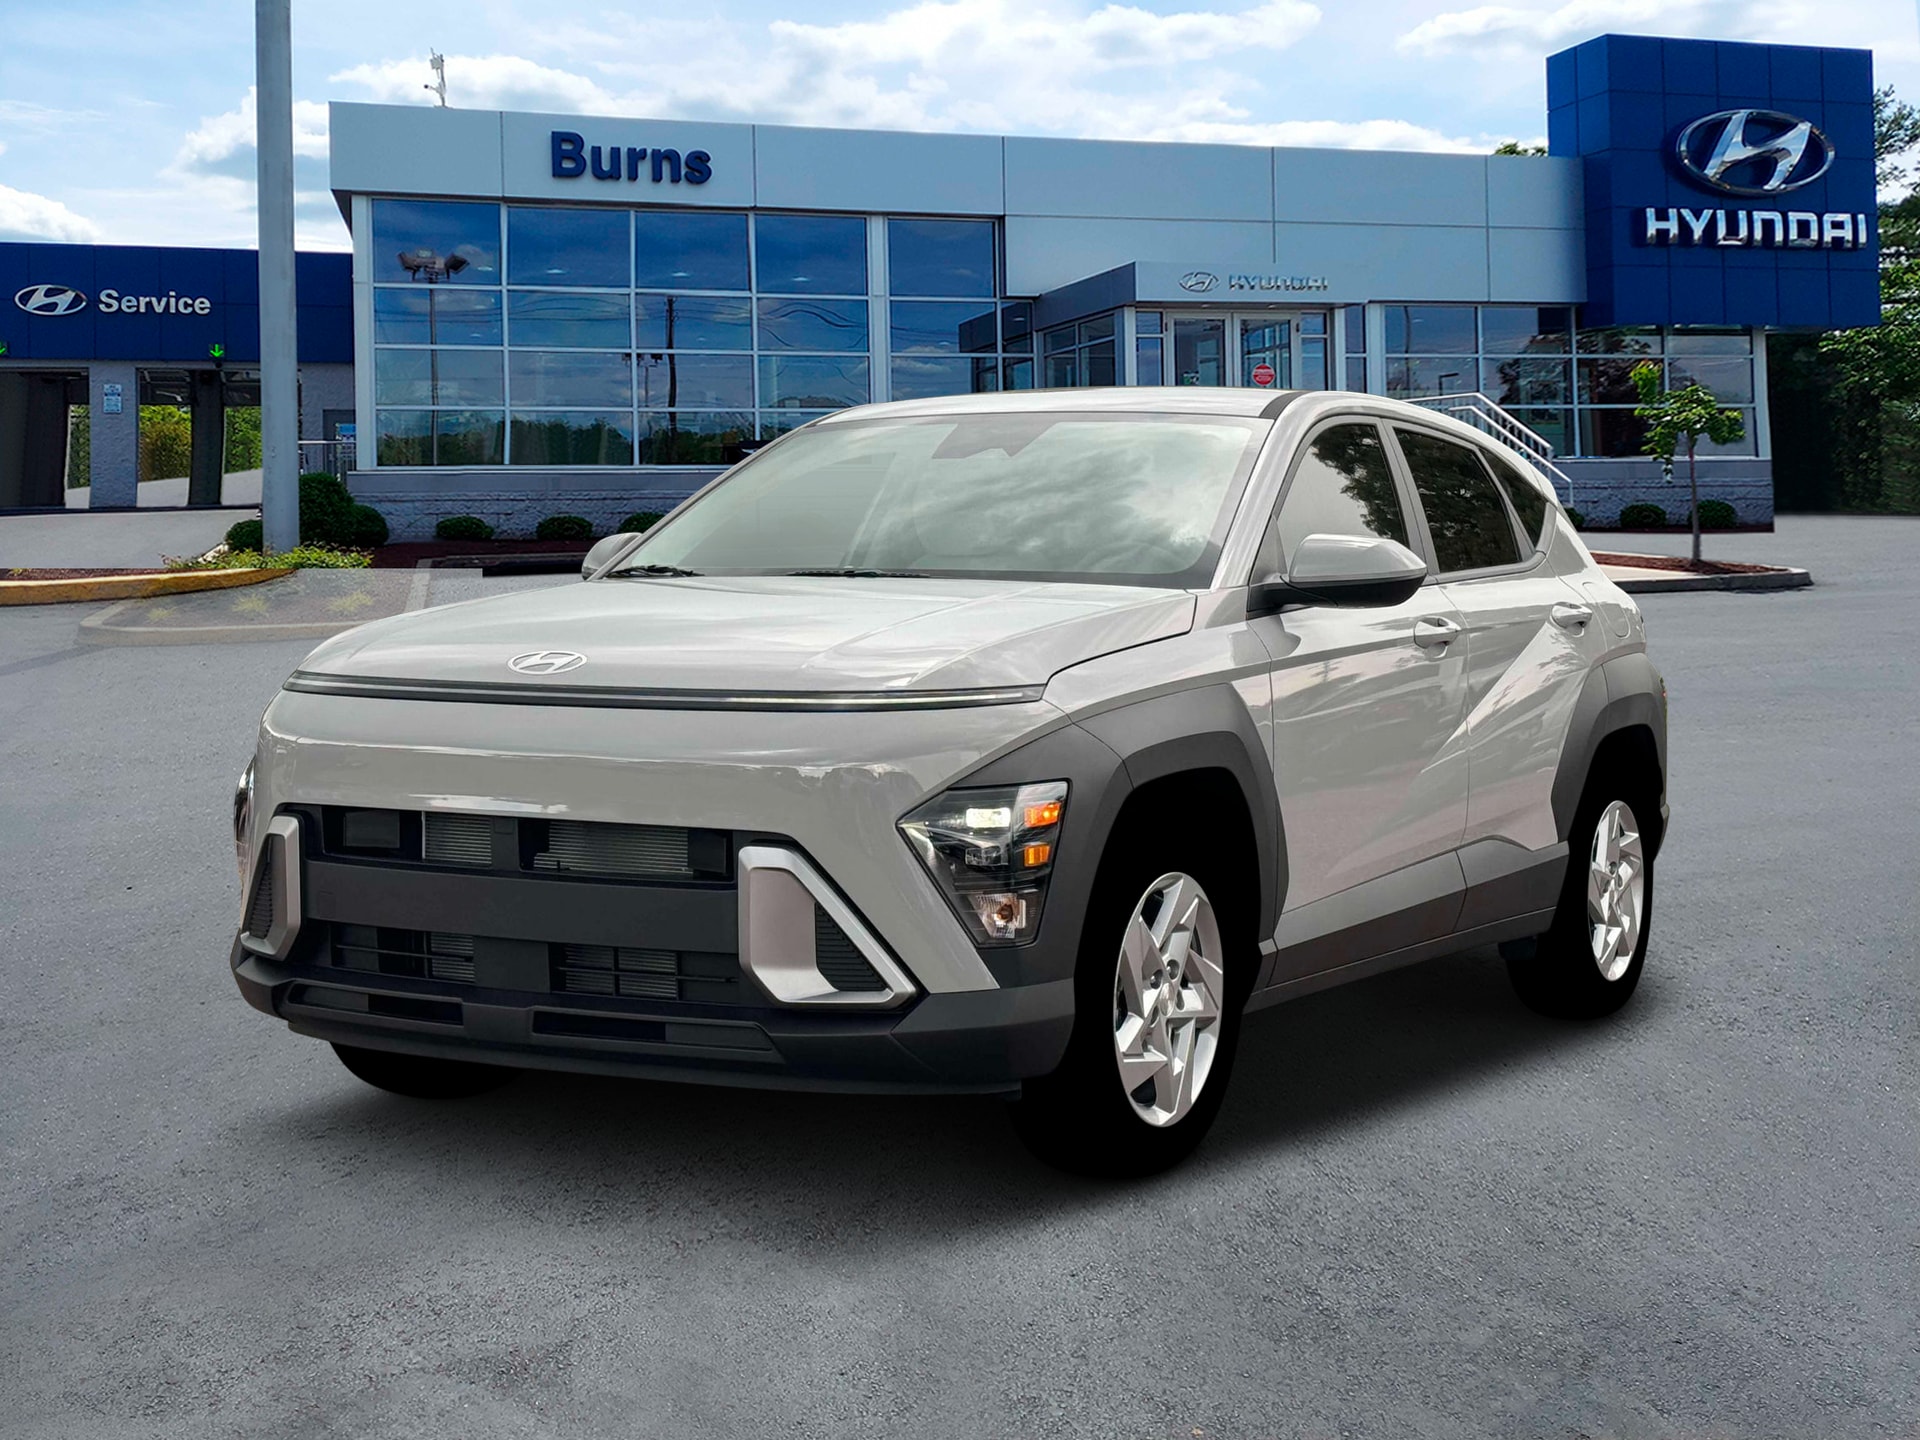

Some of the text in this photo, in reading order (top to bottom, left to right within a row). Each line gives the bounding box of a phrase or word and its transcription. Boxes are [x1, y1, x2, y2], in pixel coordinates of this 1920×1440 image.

[551, 131, 712, 184] Burns
[1645, 207, 1867, 249] HYUNDAI
[1228, 274, 1328, 291] HYUNDAI
[98, 289, 211, 315] Service
